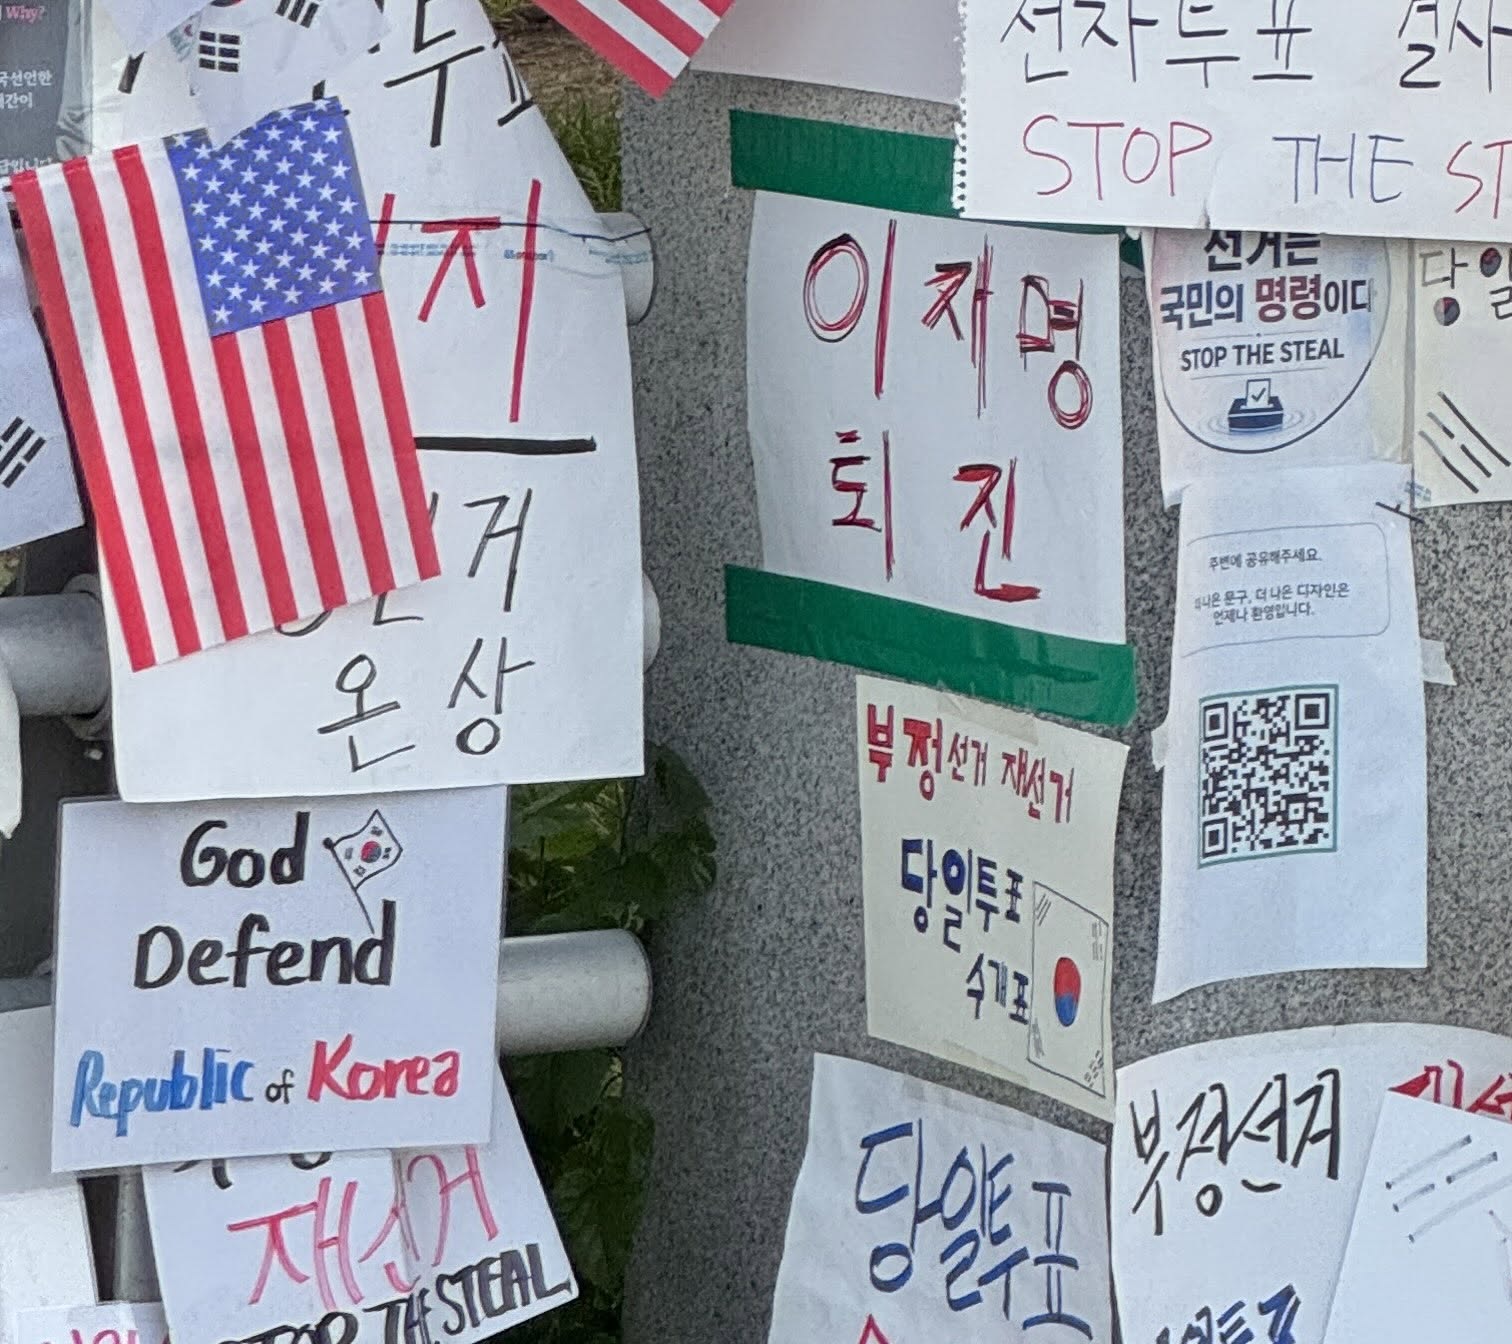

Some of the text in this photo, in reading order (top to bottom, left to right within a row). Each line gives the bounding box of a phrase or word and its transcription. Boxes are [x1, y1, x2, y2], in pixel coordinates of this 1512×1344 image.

[1022, 114, 1213, 201] STOP
[1271, 132, 1415, 205] THE
[802, 218, 1094, 430] 이재명
[1160, 273, 1376, 331] 국민의 명령이다
[1180, 337, 1345, 373] STOP THE STEAL
[1212, 606, 1248, 627] 언제나
[1296, 582, 1350, 600] 디자인은
[866, 703, 1076, 825] 부정선거 재선거
[180, 810, 310, 888] God
[900, 836, 1025, 955] 당일투표
[132, 898, 397, 990] Defend
[965, 952, 1030, 1026] 수개표
[69, 1033, 460, 1138] Republic of Korea
[855, 1118, 1093, 1341] 당일투표
[435, 1242, 572, 1336] STEAL
